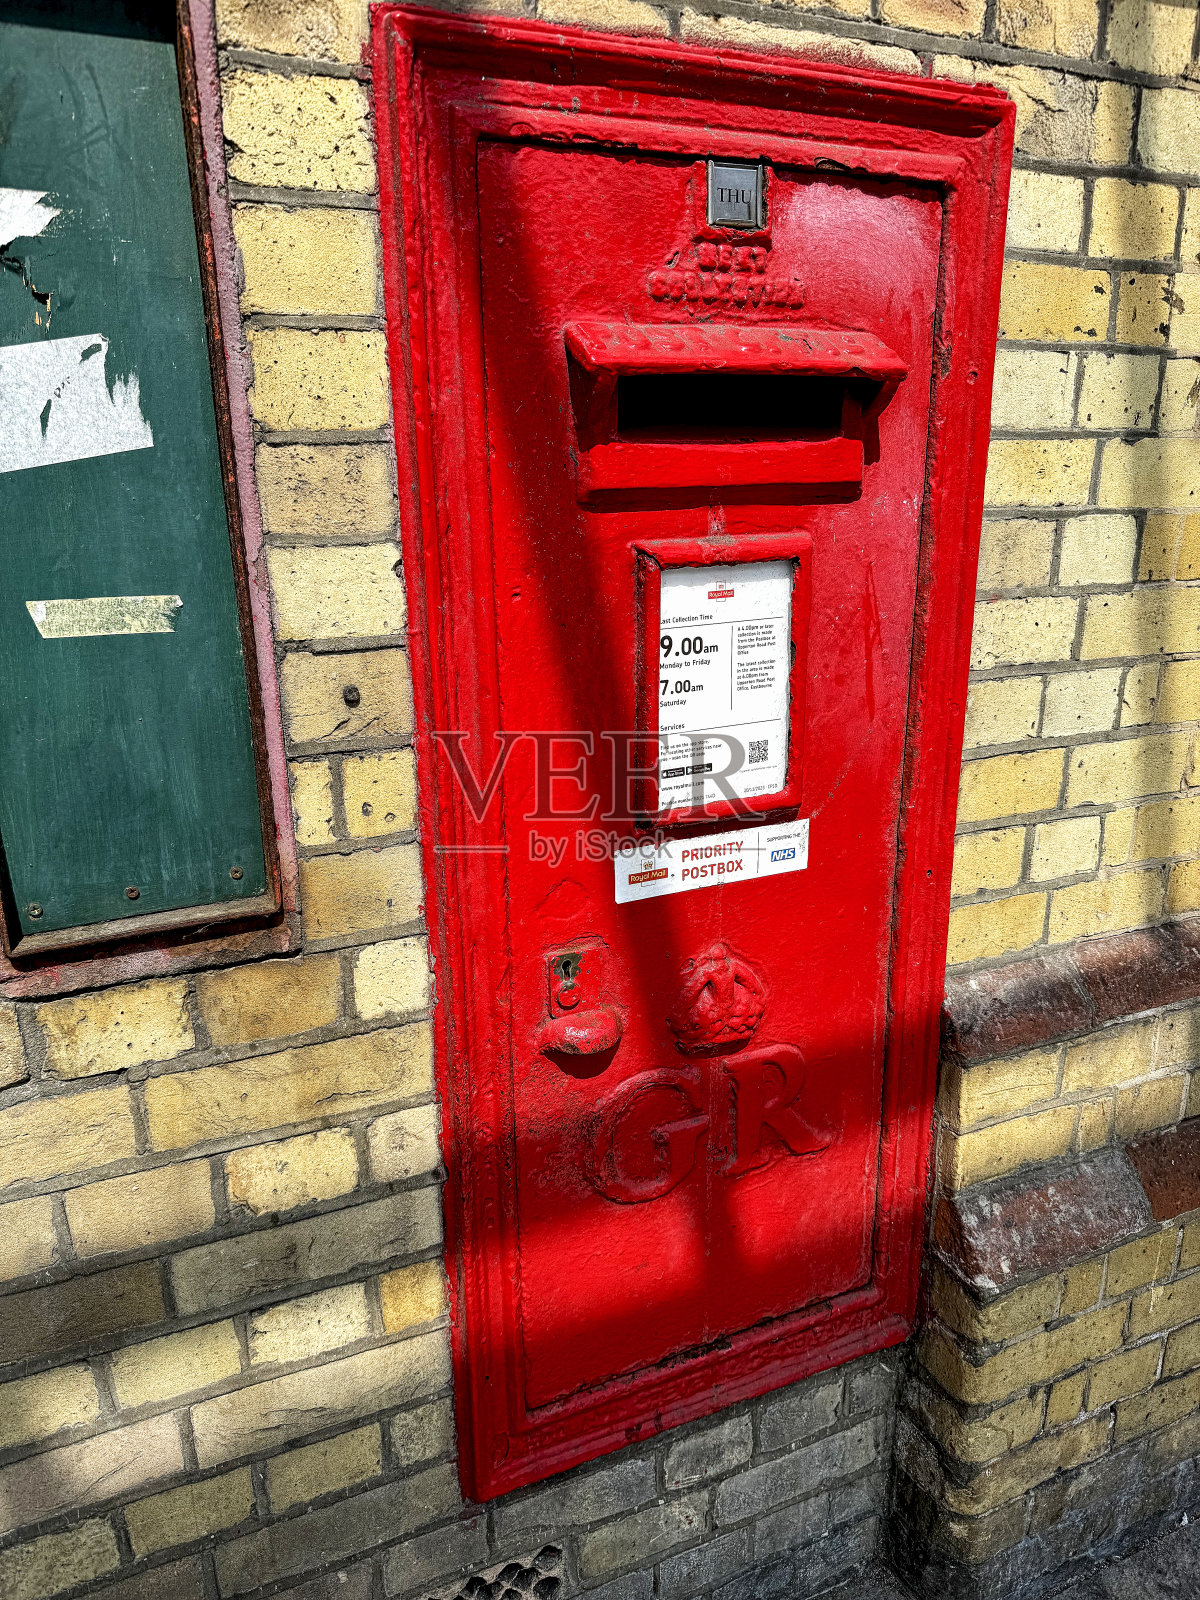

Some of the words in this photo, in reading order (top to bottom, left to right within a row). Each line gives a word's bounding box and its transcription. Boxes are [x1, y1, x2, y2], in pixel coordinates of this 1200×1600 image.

[717, 187, 752, 204] THU
[672, 615, 699, 623] Collection
[660, 635, 719, 658] 9.00am
[660, 661, 682, 669] Monday
[692, 658, 711, 666] Friday
[660, 680, 704, 696] 7.00am
[660, 699, 687, 707] Saturday
[660, 723, 685, 732] Services
[681, 841, 744, 862] PRIORITY
[681, 859, 744, 881] POSTBOX
[772, 848, 795, 861] NHS
[630, 872, 650, 882] Royal
[650, 869, 666, 878] Mail
